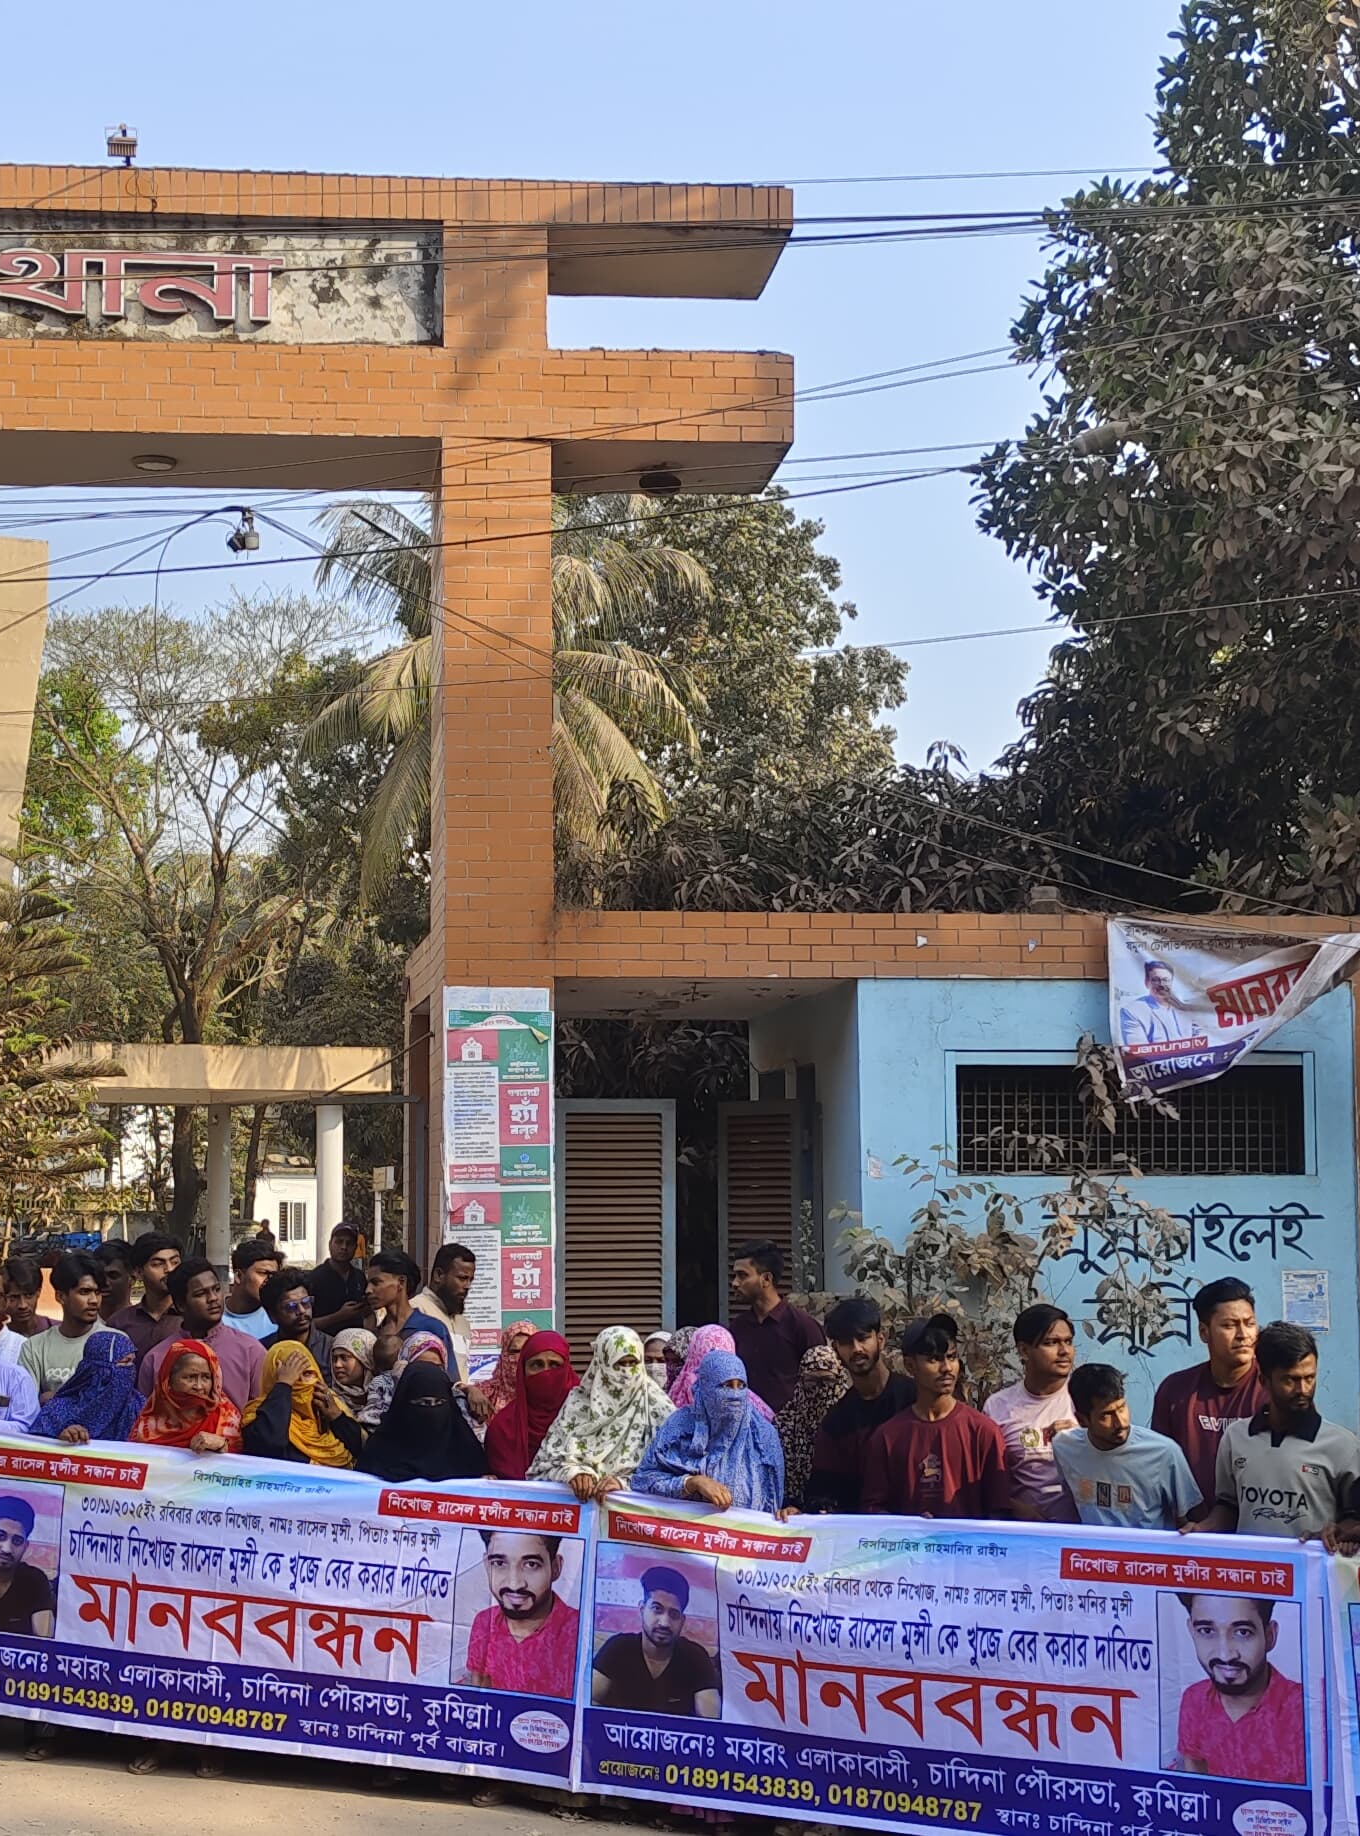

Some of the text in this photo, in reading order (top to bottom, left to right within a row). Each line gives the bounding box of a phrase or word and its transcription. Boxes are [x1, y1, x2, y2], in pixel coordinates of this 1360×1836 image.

[1129, 1053, 1215, 1081] আয়োজনে
[1240, 1486, 1308, 1510] TOYOTA
[68, 1521, 124, 1565] চান্দিনায়
[128, 1526, 176, 1571] নিখোজ
[182, 1537, 225, 1575] রাসেল
[261, 1551, 284, 1580] কে
[290, 1548, 322, 1593] খুজে
[325, 1559, 353, 1589] বের
[358, 1555, 398, 1595] করার
[401, 1556, 451, 1600] দাবিতে
[70, 1572, 434, 1676] মানববন্ধন
[55, 1652, 111, 1685] মহারং
[119, 1664, 231, 1702] এলাকাবাসী,
[241, 1672, 312, 1707] চান্দিনা
[320, 1683, 412, 1724] পৌরসভা,
[423, 1692, 501, 1730] কুমিল্লা।
[732, 1649, 1140, 1761] মানববন্ধন
[599, 1759, 1113, 1836] প্রয়োজনেঃ 01891543839, 01870948787 স্থানঃ চান্দিনা
[603, 1722, 716, 1758] আয়োজনেঃ
[724, 1735, 788, 1768] মহারং
[795, 1747, 918, 1789] এলাকাবাসী,
[927, 1757, 1006, 1794] চান্দিনা
[1015, 1765, 1120, 1813] পৌরসভা,
[1131, 1780, 1221, 1822] কুমিল্লা।
